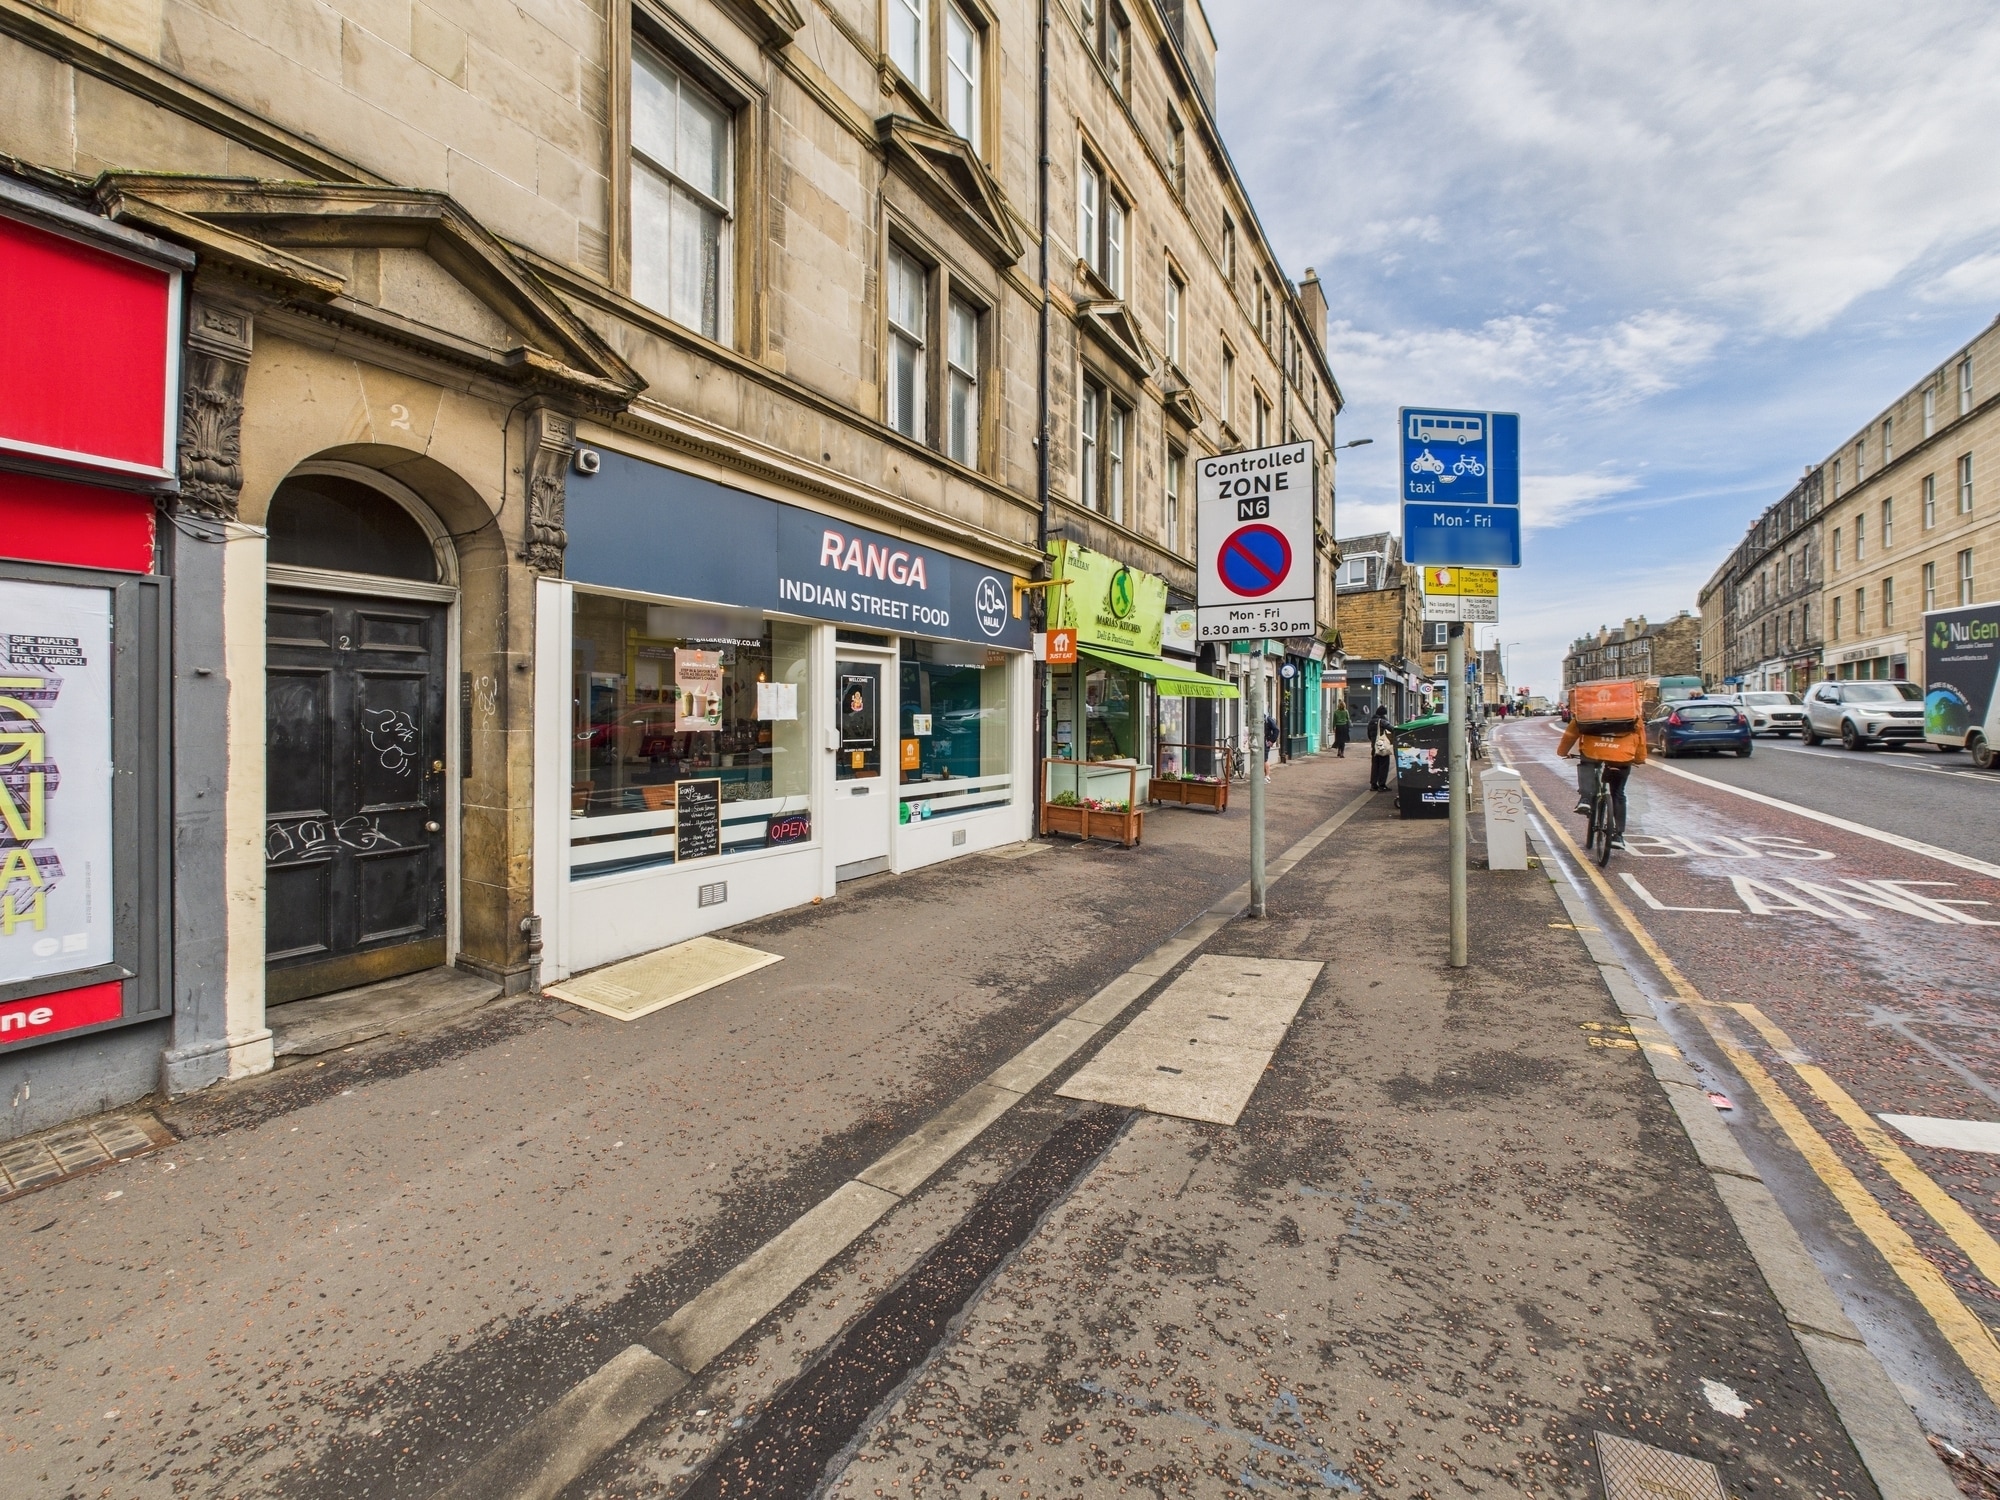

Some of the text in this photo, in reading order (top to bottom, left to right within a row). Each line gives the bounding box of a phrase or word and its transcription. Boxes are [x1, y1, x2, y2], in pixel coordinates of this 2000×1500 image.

[390, 404, 410, 430] 2
[1204, 448, 1305, 477] Controlled
[1219, 472, 1289, 499] ZONE
[1409, 480, 1435, 494] taxi
[1240, 500, 1267, 518] N6
[1433, 513, 1463, 527] Mon
[1474, 514, 1492, 528] Fri
[820, 529, 927, 590] RANGA
[1067, 556, 1090, 571] ITALIAN
[779, 578, 950, 627] INDIAN STREET FOOD
[1229, 610, 1254, 621] Mon
[1264, 608, 1280, 619] Fri
[983, 616, 1000, 629] HALAL
[1119, 620, 1142, 634] KITCHEN
[1202, 624, 1230, 635] 8.30
[1232, 624, 1250, 634] am
[1259, 621, 1289, 633] 5.30
[1291, 621, 1310, 633] pm
[1096, 630, 1107, 640] Deli
[1950, 620, 1999, 642] NuGen
[12, 636, 75, 646] SHE WAITS.
[339, 636, 351, 650] 2
[12, 646, 80, 656] HE LISTENS.
[12, 655, 85, 665] THEY WATCH.
[771, 821, 809, 840] OPEN
[1622, 833, 1837, 860] BUS
[1618, 873, 2000, 927] LANE
